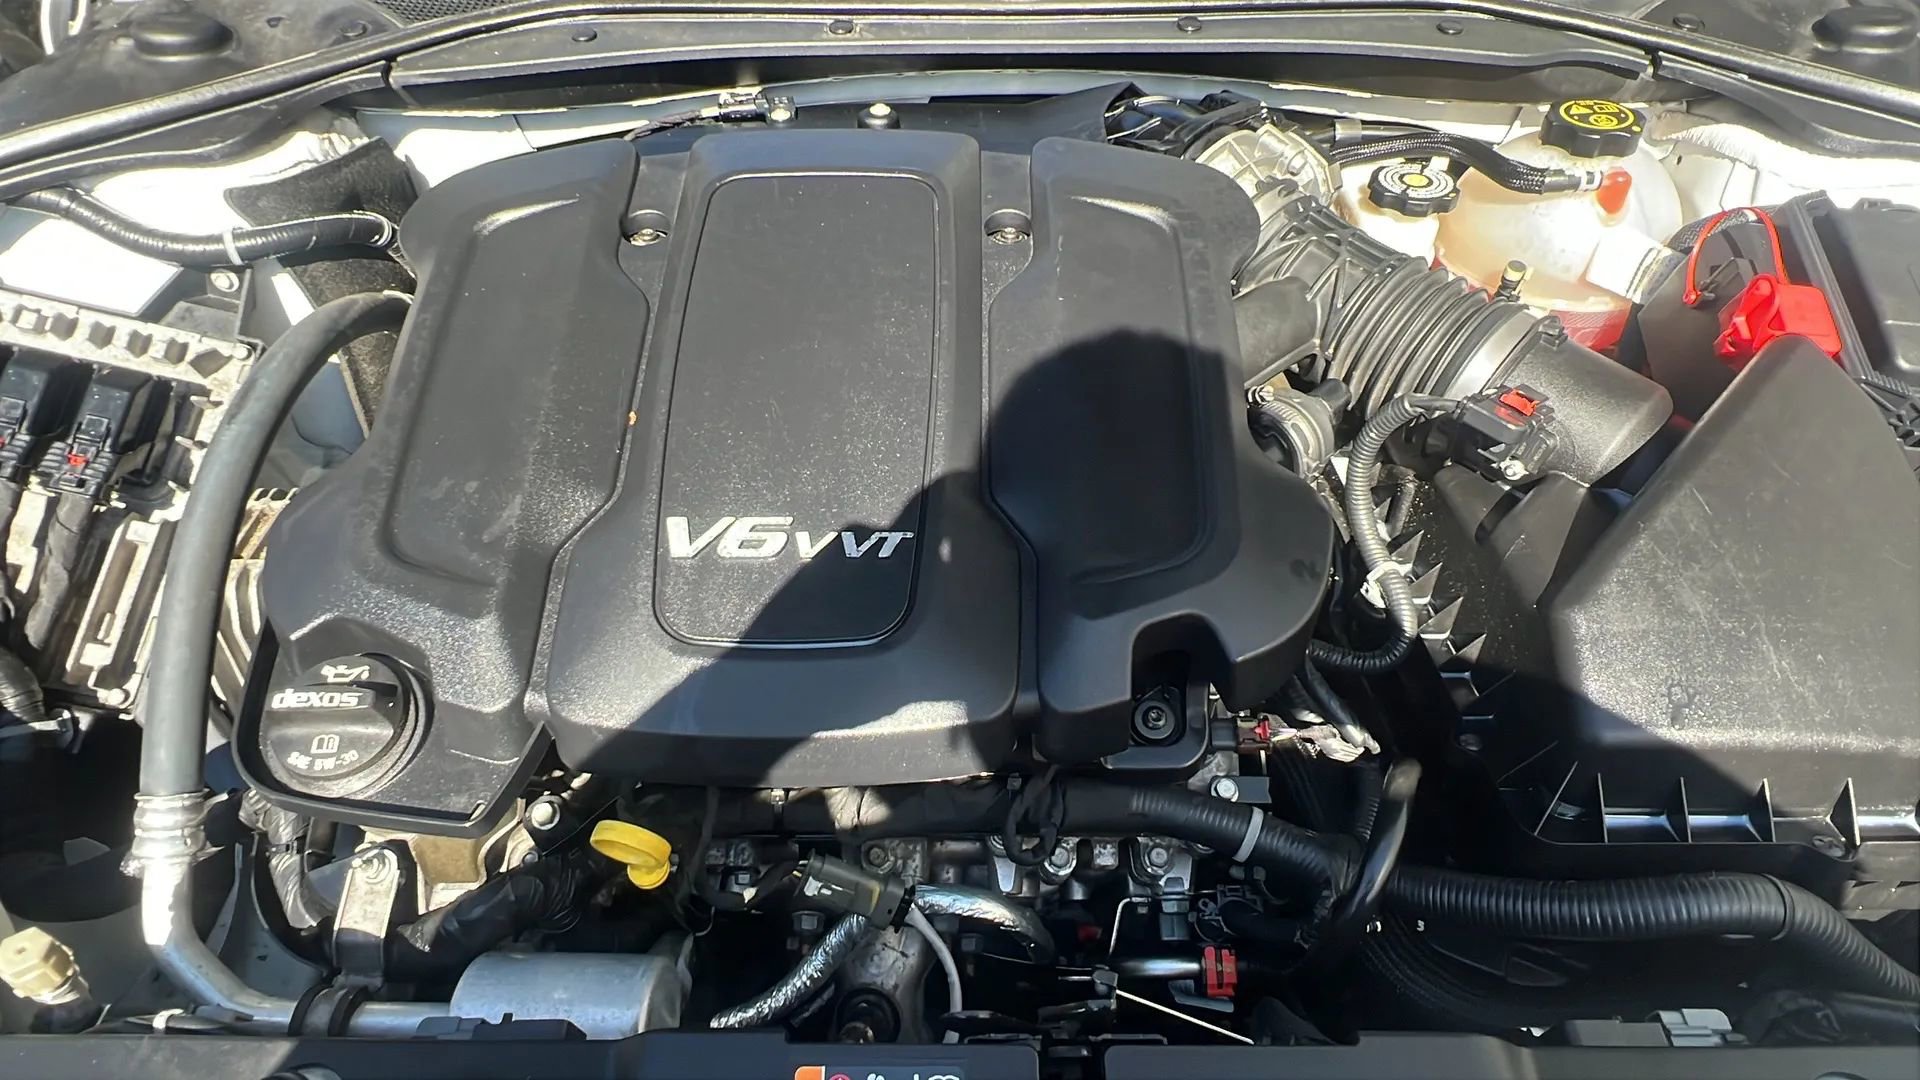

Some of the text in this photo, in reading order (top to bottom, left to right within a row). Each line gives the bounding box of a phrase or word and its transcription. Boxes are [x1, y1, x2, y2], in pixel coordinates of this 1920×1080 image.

[666, 516, 914, 560] V6 VVT
[271, 688, 363, 709] dexos
